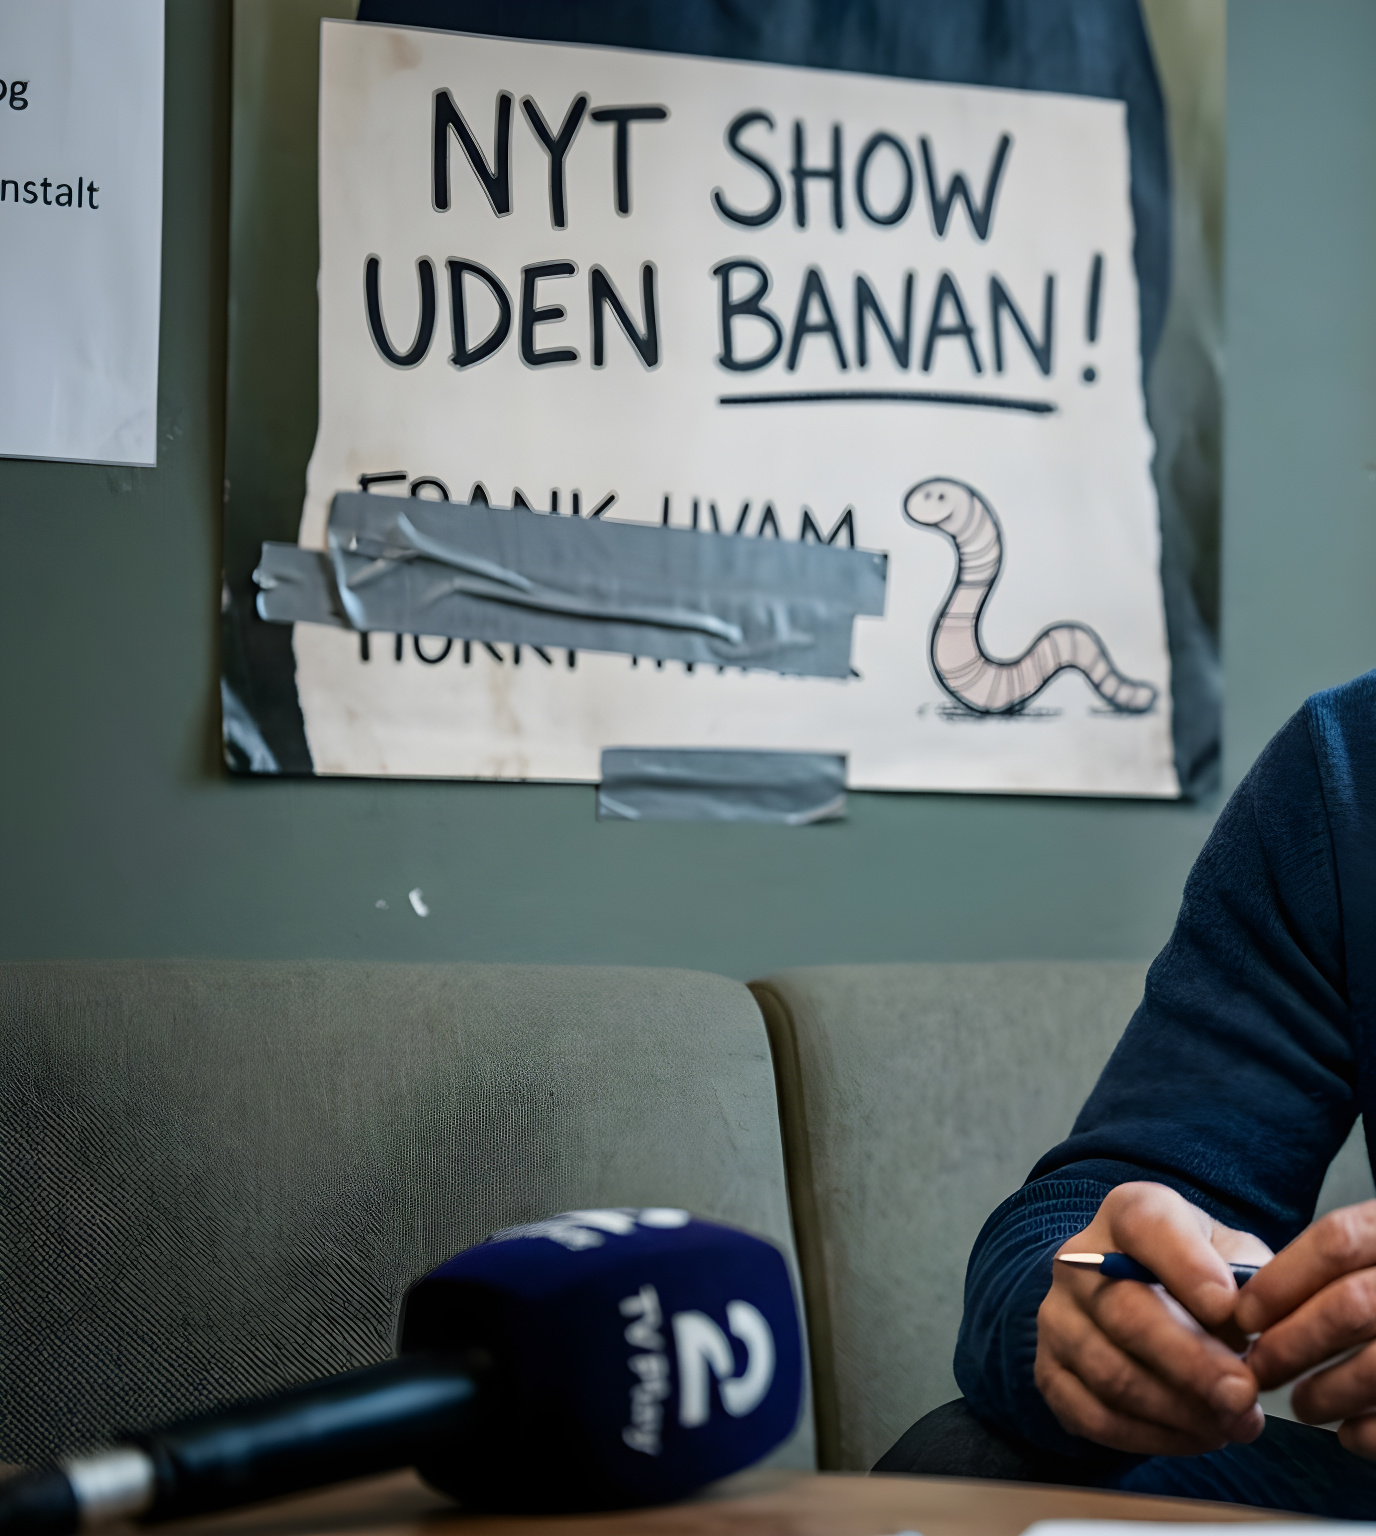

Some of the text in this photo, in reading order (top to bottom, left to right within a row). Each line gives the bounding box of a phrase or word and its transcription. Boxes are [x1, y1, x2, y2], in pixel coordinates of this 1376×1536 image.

[0, 176, 100, 210] nstalt
[430, 87, 1012, 241] NYT SHOW
[364, 253, 1104, 384] UDEN BANAN!
[671, 1299, 777, 1428] 2
